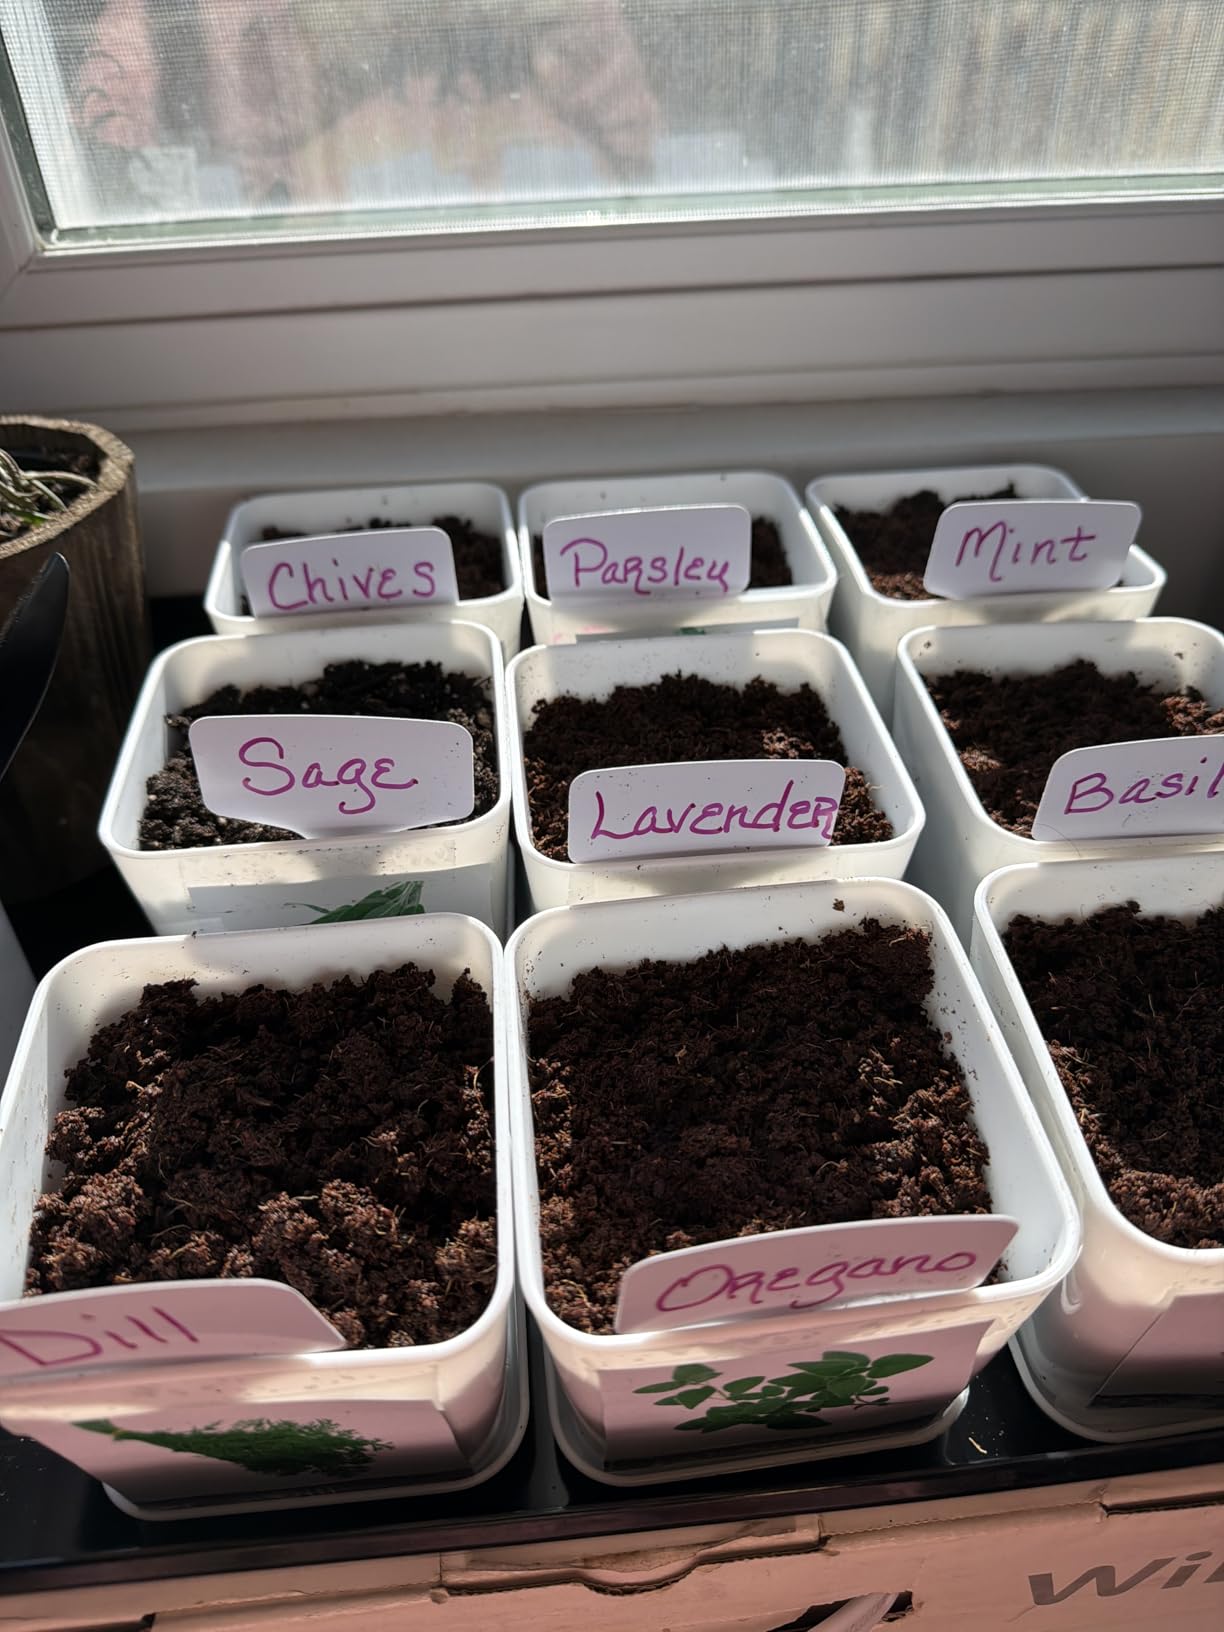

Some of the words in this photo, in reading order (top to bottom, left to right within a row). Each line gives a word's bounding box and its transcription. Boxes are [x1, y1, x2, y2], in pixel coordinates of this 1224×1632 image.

[955, 520, 1097, 583] Mint
[267, 561, 435, 610] Chives
[238, 736, 419, 815] Sage
[1064, 760, 1224, 815] Basil
[0, 1306, 199, 1367] Dill
